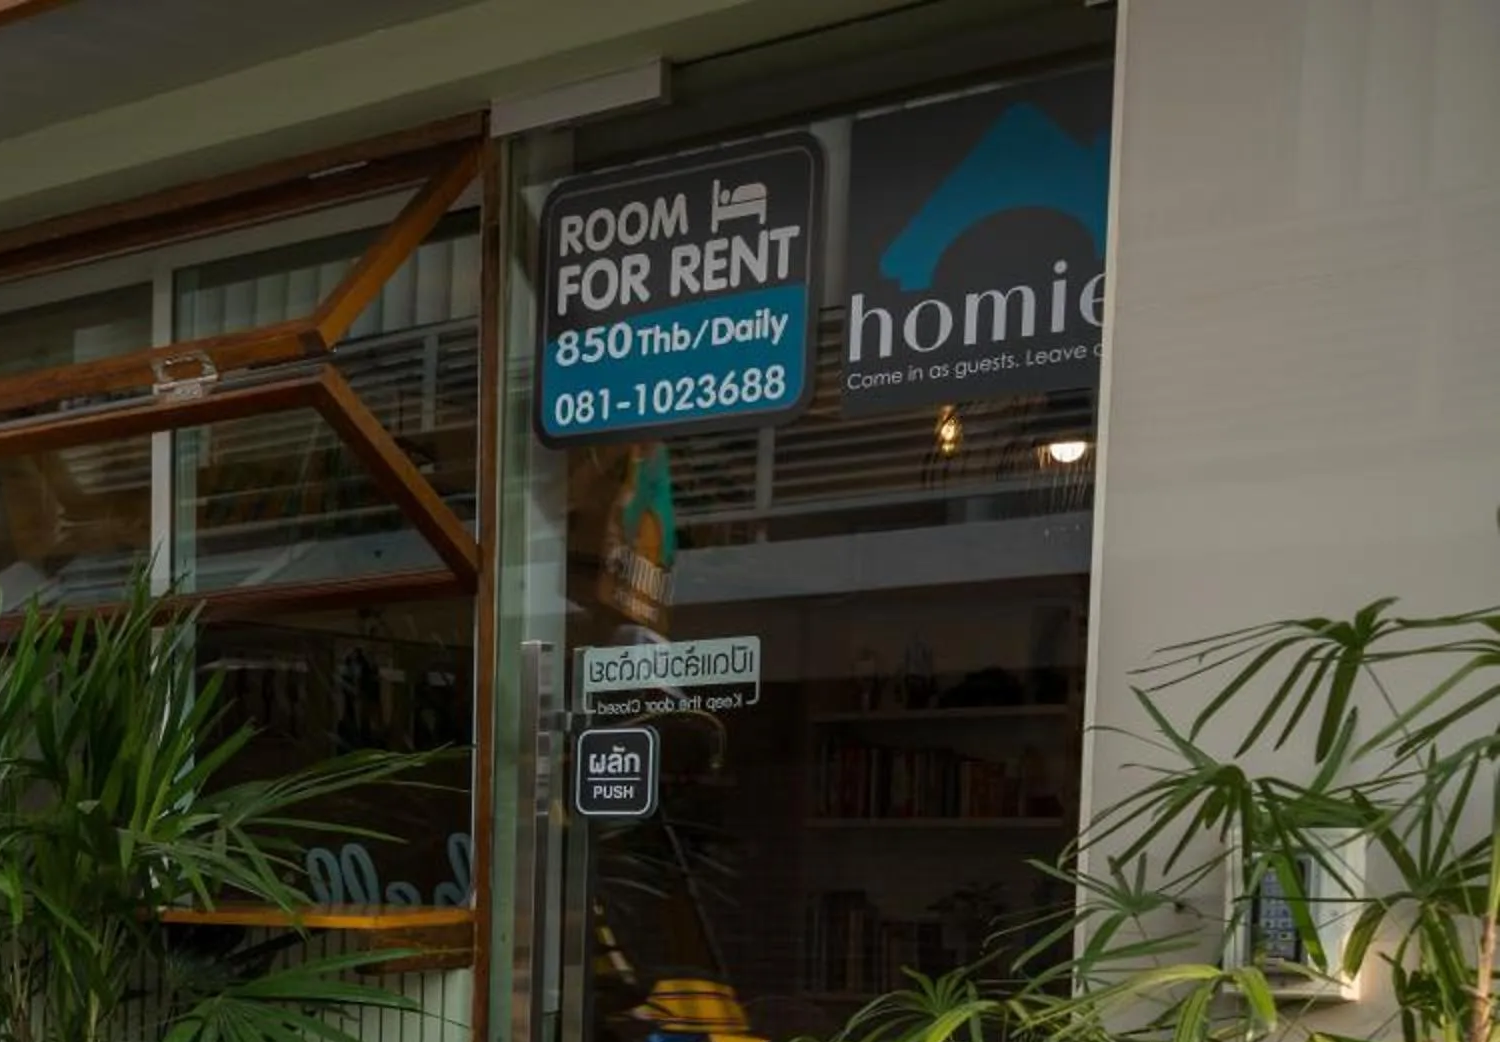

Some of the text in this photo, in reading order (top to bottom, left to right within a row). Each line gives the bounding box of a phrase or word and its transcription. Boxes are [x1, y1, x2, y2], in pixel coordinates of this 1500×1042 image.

[559, 193, 688, 257] ROOM
[557, 225, 800, 316] FOR RENT
[555, 307, 789, 367] 850 Thb/Daily
[847, 370, 902, 391] Come
[907, 364, 924, 382] in
[929, 363, 950, 380] as
[955, 352, 1019, 379] guests.
[1026, 343, 1087, 367] Leave
[554, 364, 786, 427] 081-1023688
[589, 745, 641, 774] ผลัก
[593, 785, 634, 800] PUSH
